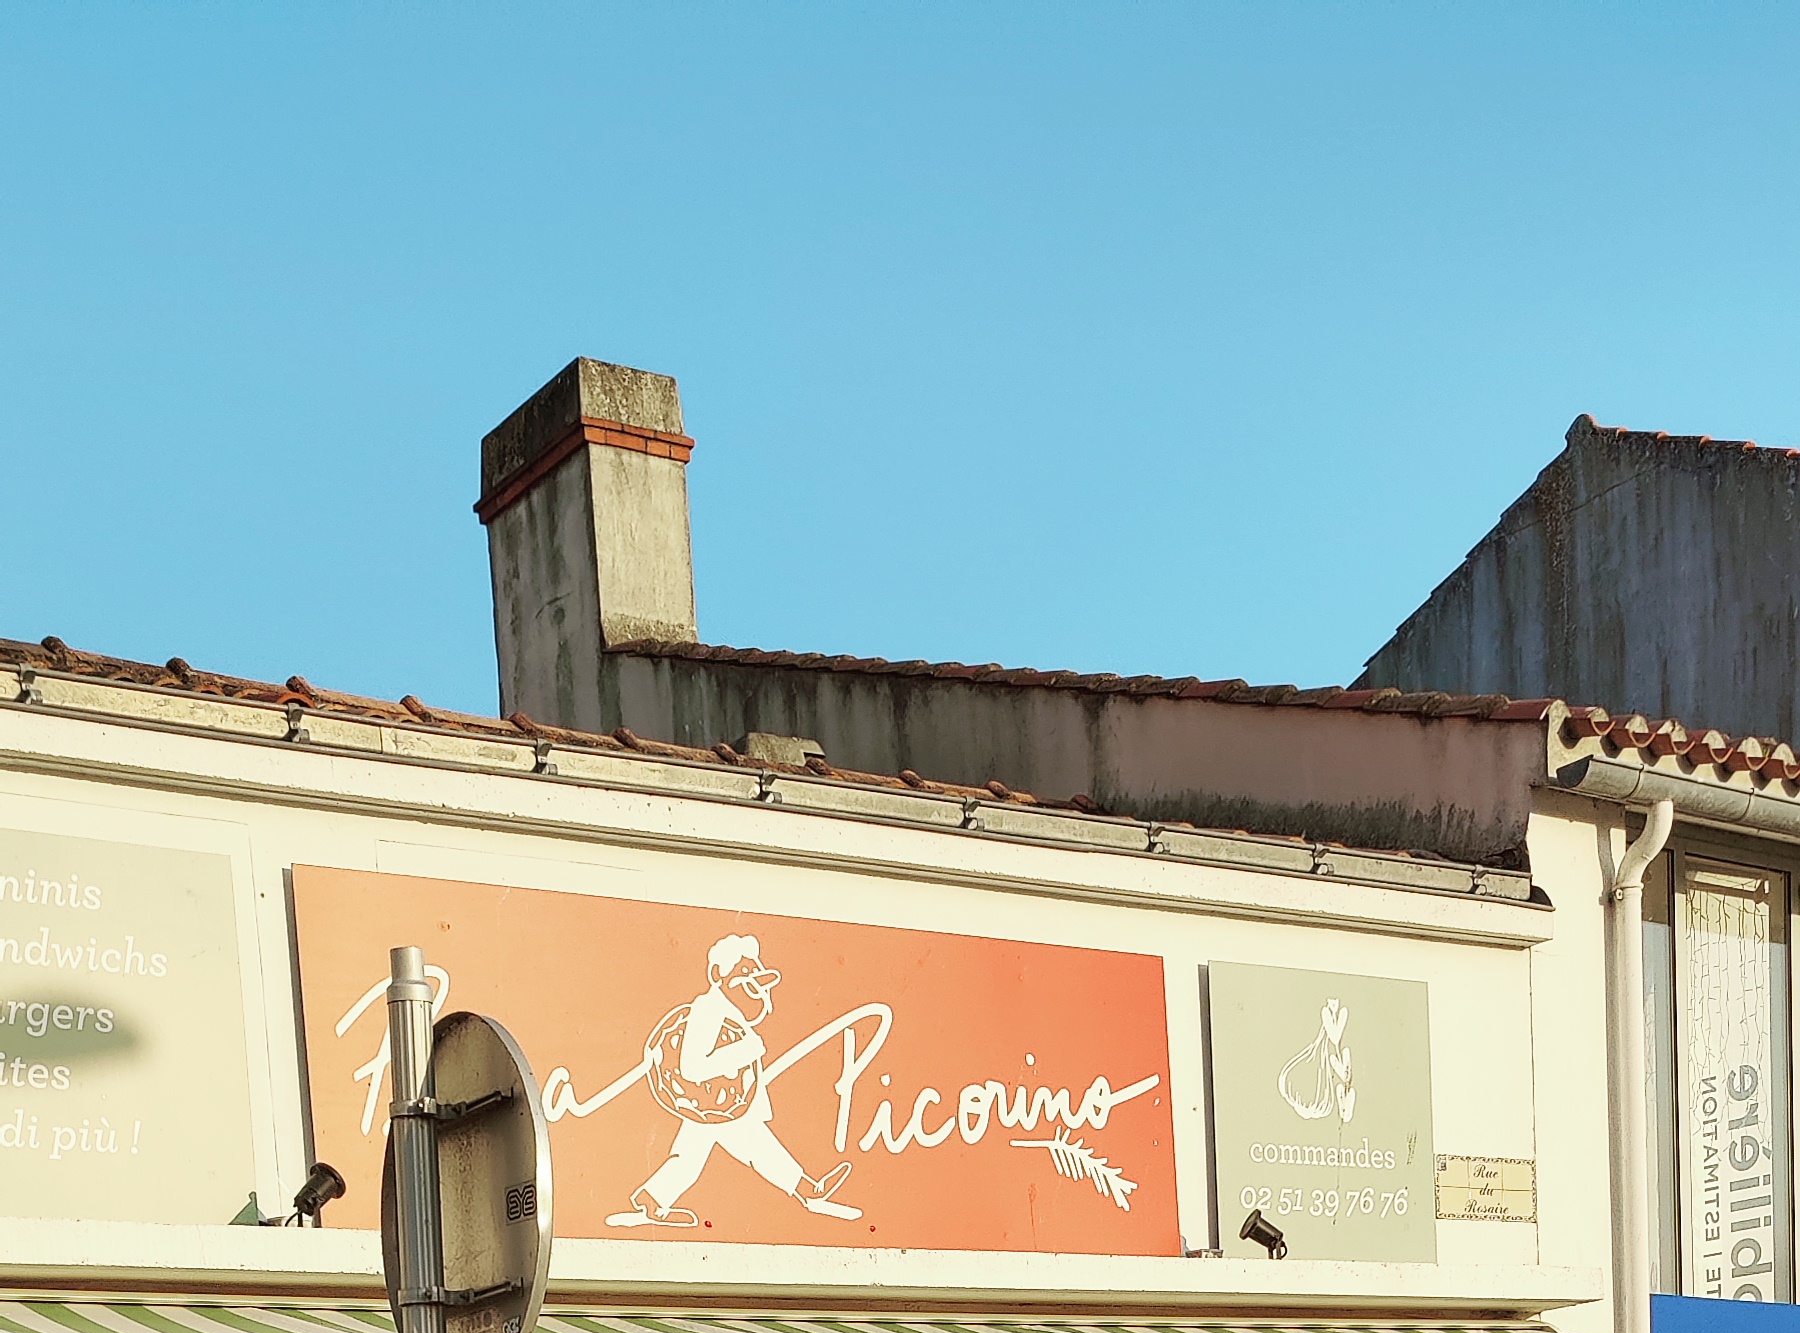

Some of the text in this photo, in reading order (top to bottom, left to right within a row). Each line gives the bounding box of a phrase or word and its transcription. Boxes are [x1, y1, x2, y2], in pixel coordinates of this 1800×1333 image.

[764, 1003, 1160, 1153] Picorino
[1249, 1137, 1396, 1170] commandes
[1473, 1164, 1499, 1178] Rue
[1479, 1183, 1494, 1196] du
[1240, 1186, 1410, 1218] 02 51 39 76 76
[1464, 1199, 1509, 1214] Rosaire
